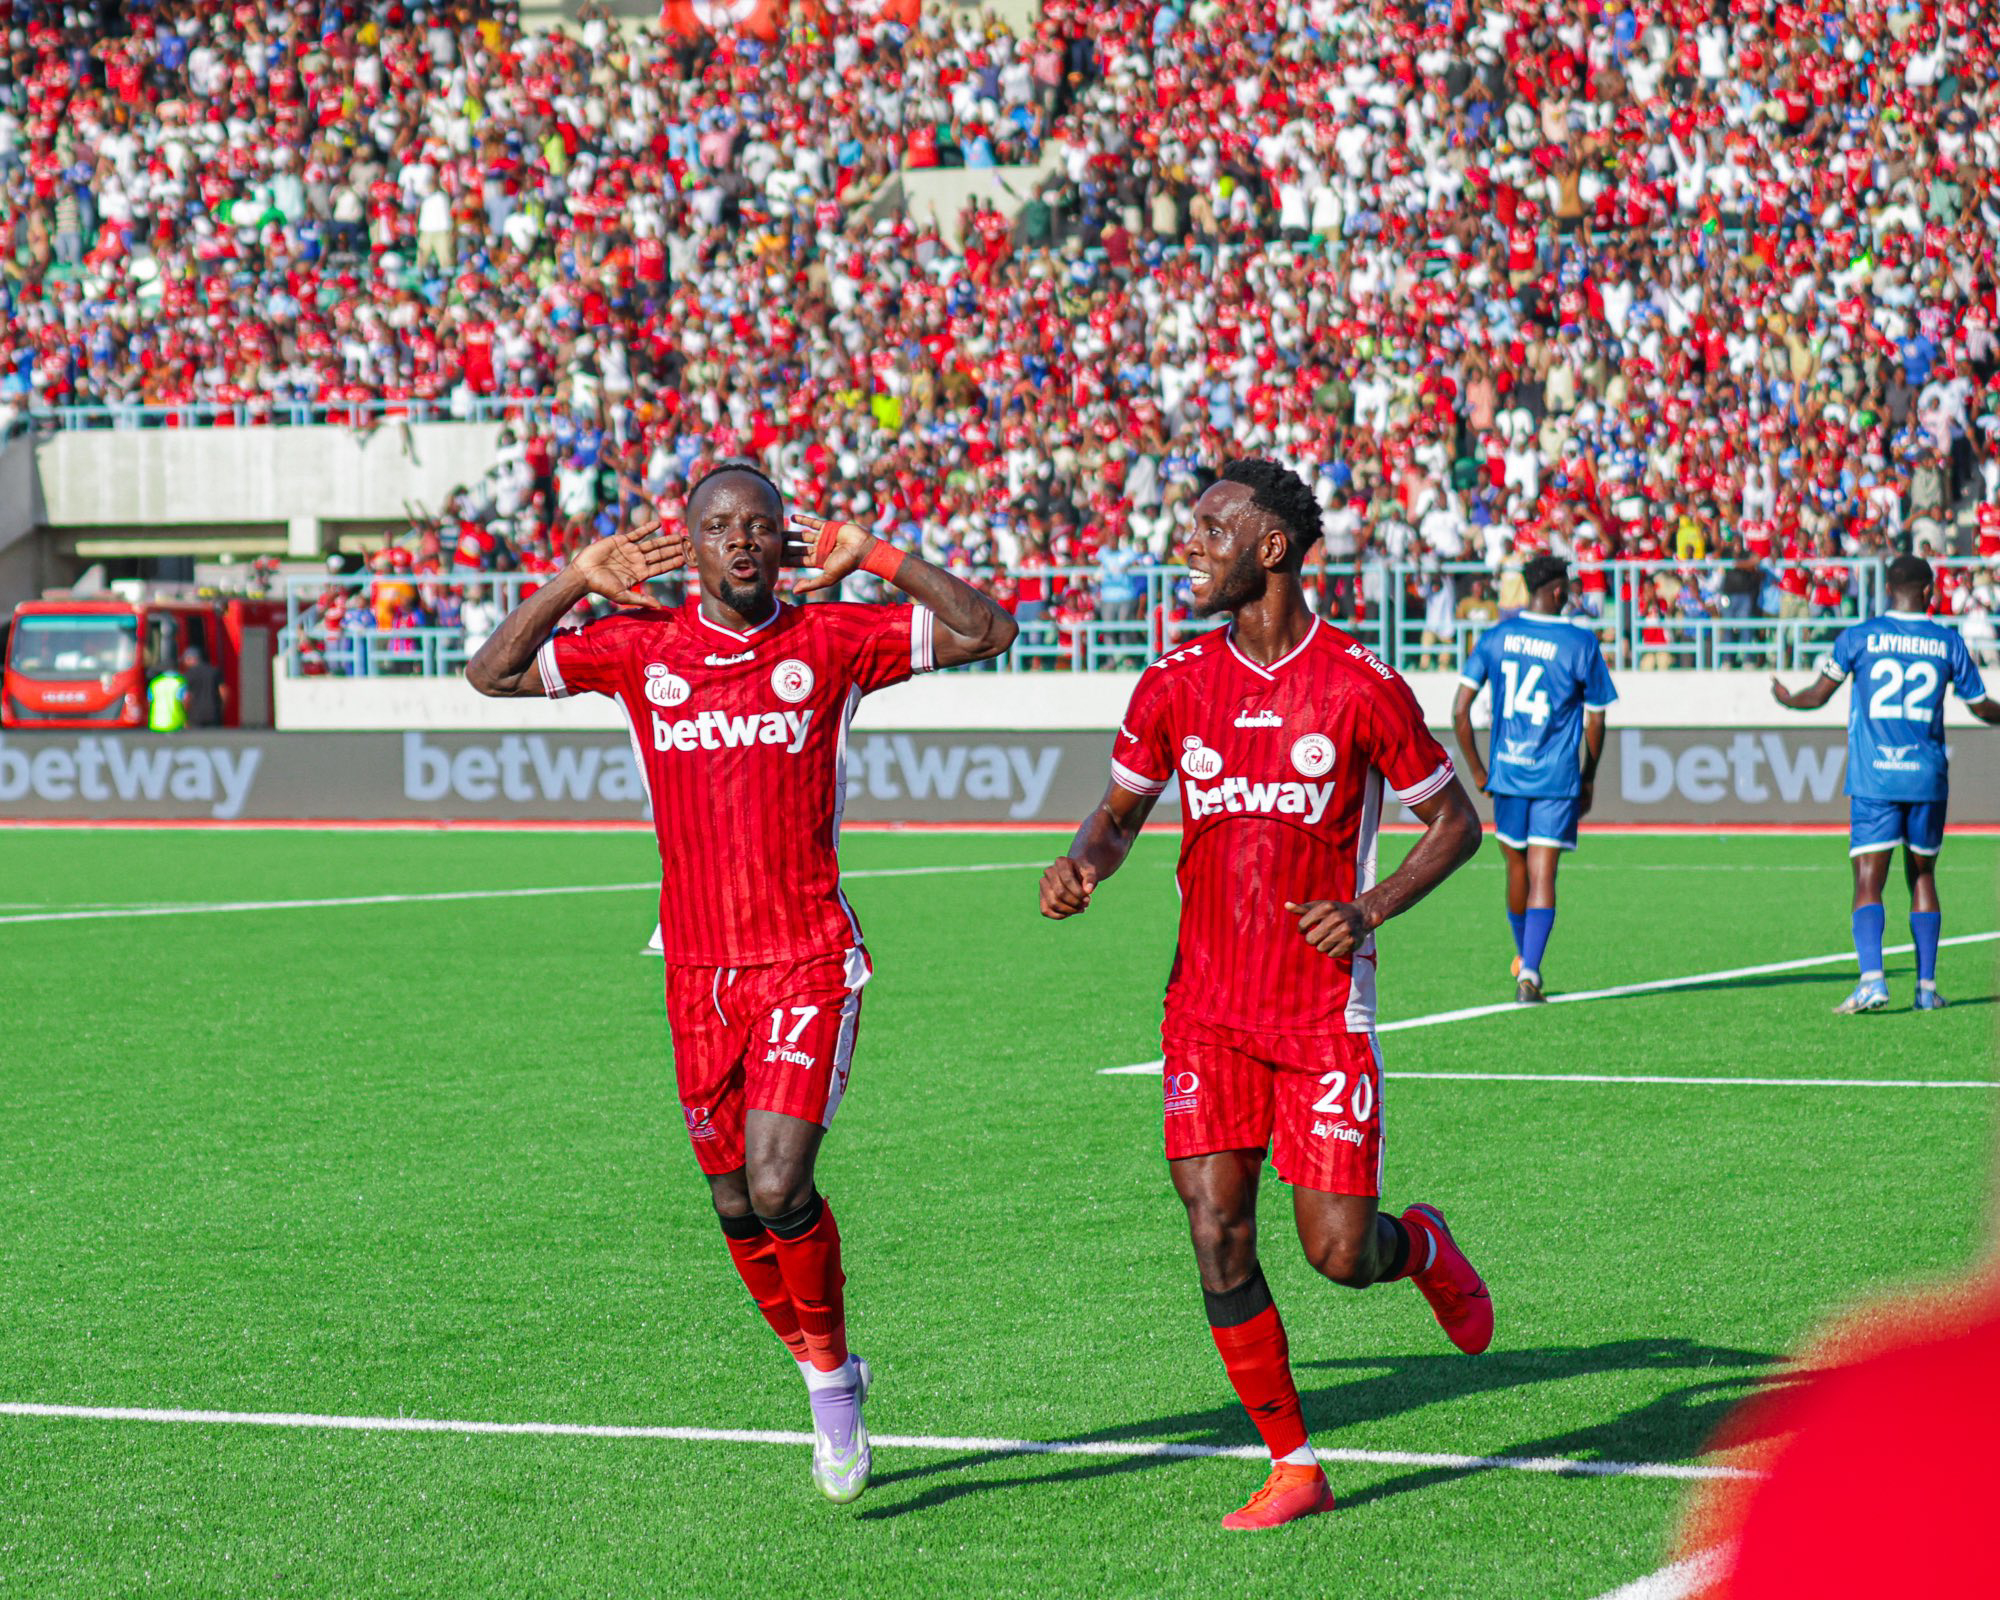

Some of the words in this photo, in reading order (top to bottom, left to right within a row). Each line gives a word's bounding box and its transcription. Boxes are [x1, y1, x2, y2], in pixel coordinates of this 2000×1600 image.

[652, 679, 681, 700] Cola
[1501, 660, 1551, 725] 14
[1869, 658, 1938, 723] 22
[652, 709, 814, 754] betway
[0, 732, 262, 818] betway
[403, 731, 653, 820] betwa
[1188, 751, 1213, 773] Cola
[1619, 728, 1848, 803] betw
[1185, 776, 1336, 825] betway
[767, 1005, 819, 1043] 17
[1312, 1070, 1373, 1122] 20
